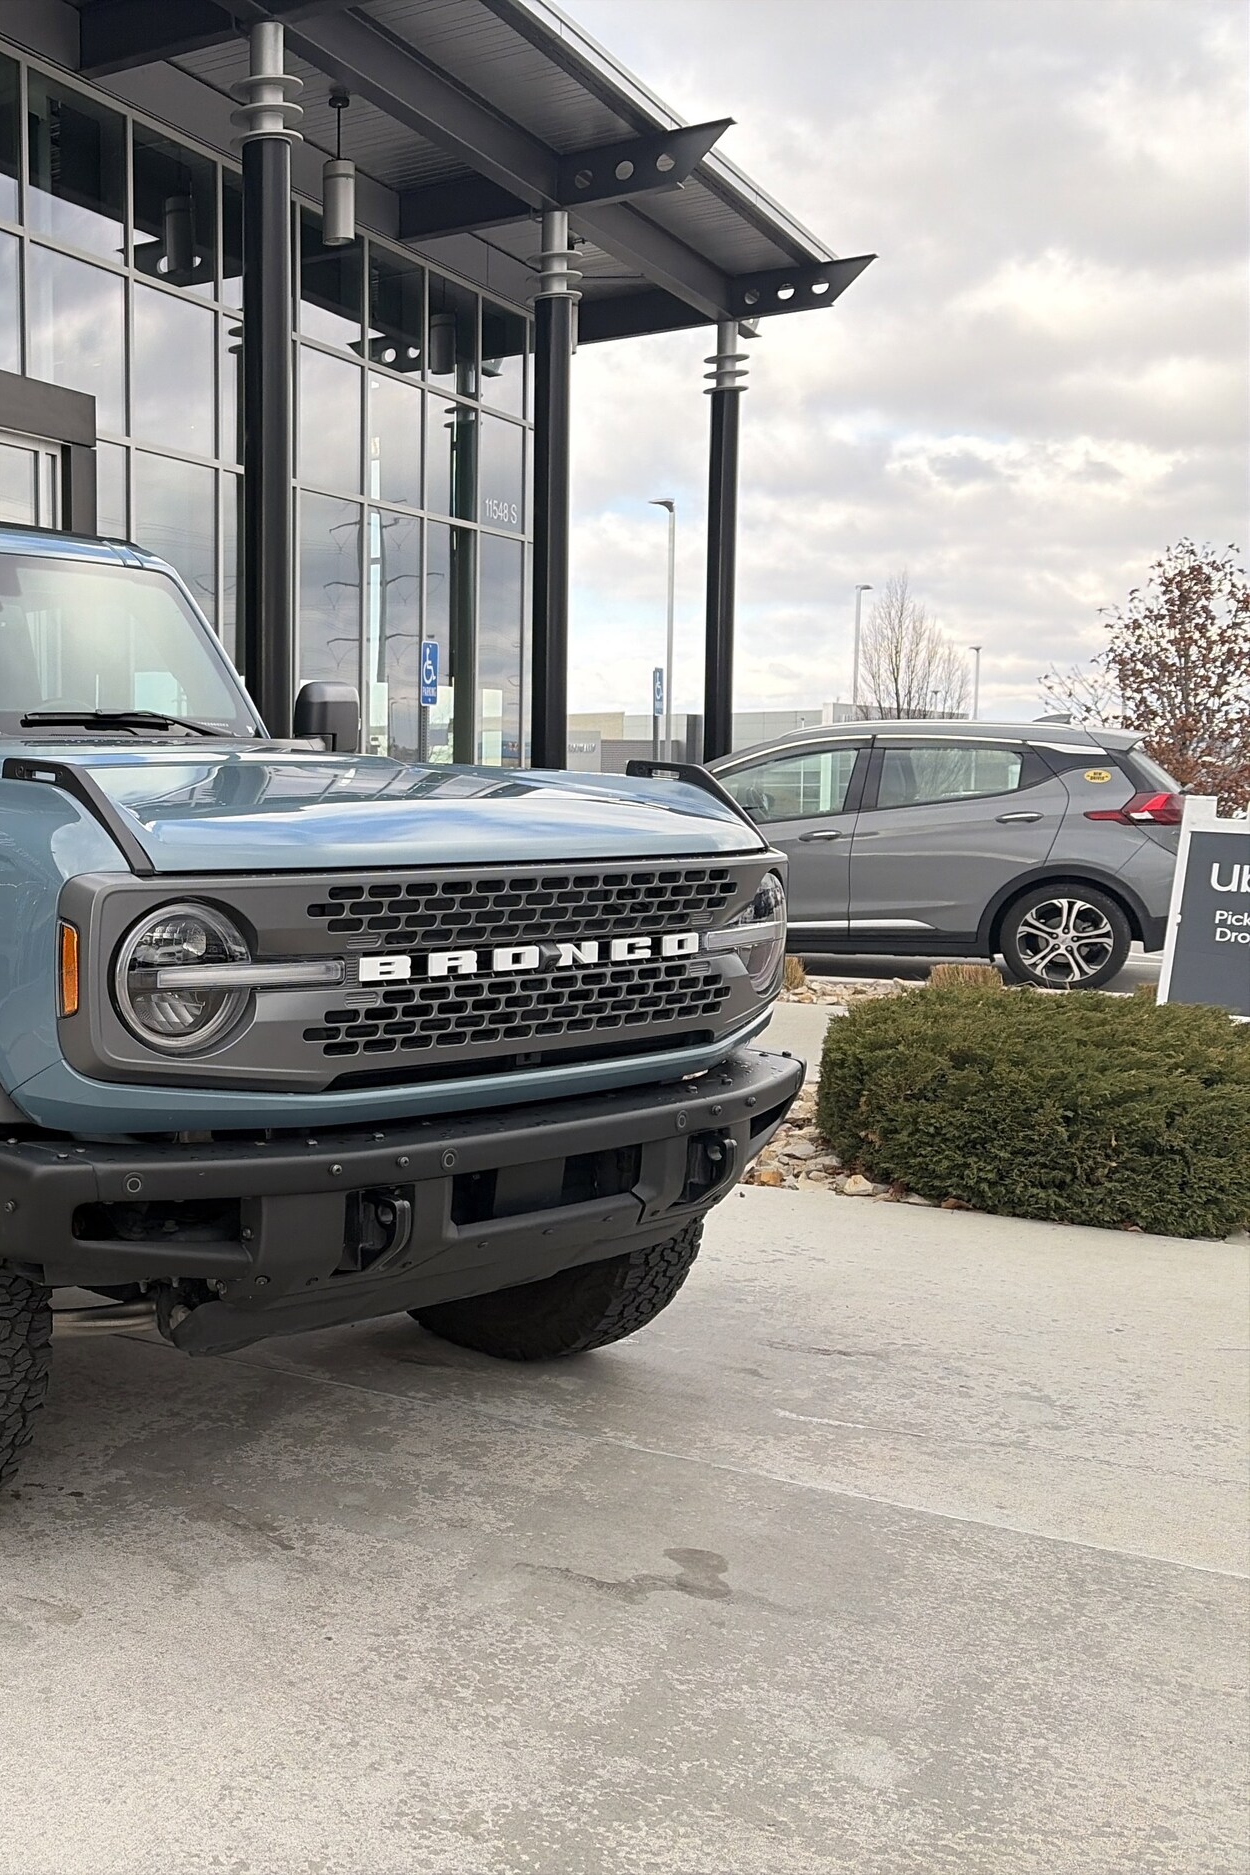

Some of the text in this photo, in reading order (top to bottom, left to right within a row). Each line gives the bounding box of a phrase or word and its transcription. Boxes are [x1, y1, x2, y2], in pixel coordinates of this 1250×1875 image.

[485, 498, 518, 524] 11548 S
[1215, 927, 1250, 946] Dro
[358, 932, 699, 982] BRONCO
